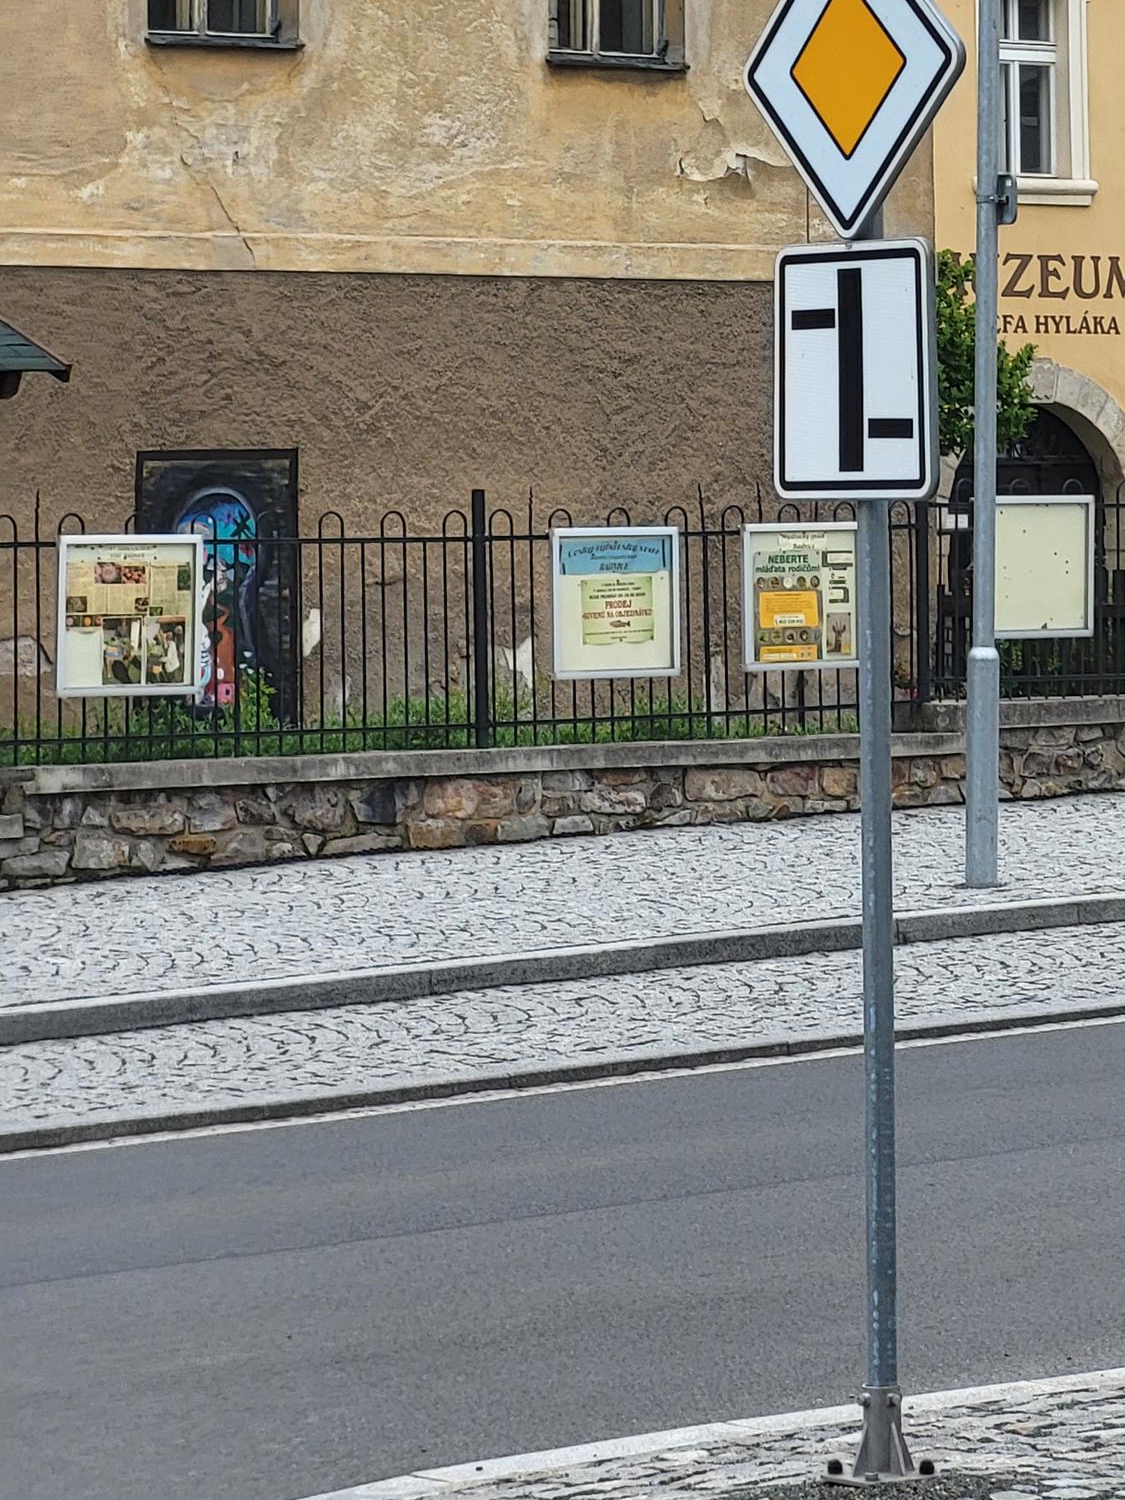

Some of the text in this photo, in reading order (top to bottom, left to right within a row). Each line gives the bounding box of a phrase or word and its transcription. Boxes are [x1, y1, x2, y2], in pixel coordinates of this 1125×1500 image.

[1035, 311, 1121, 335] HYLÁKA
[768, 554, 808, 564] NEBERTE
[605, 600, 632, 609] PRODEJ
